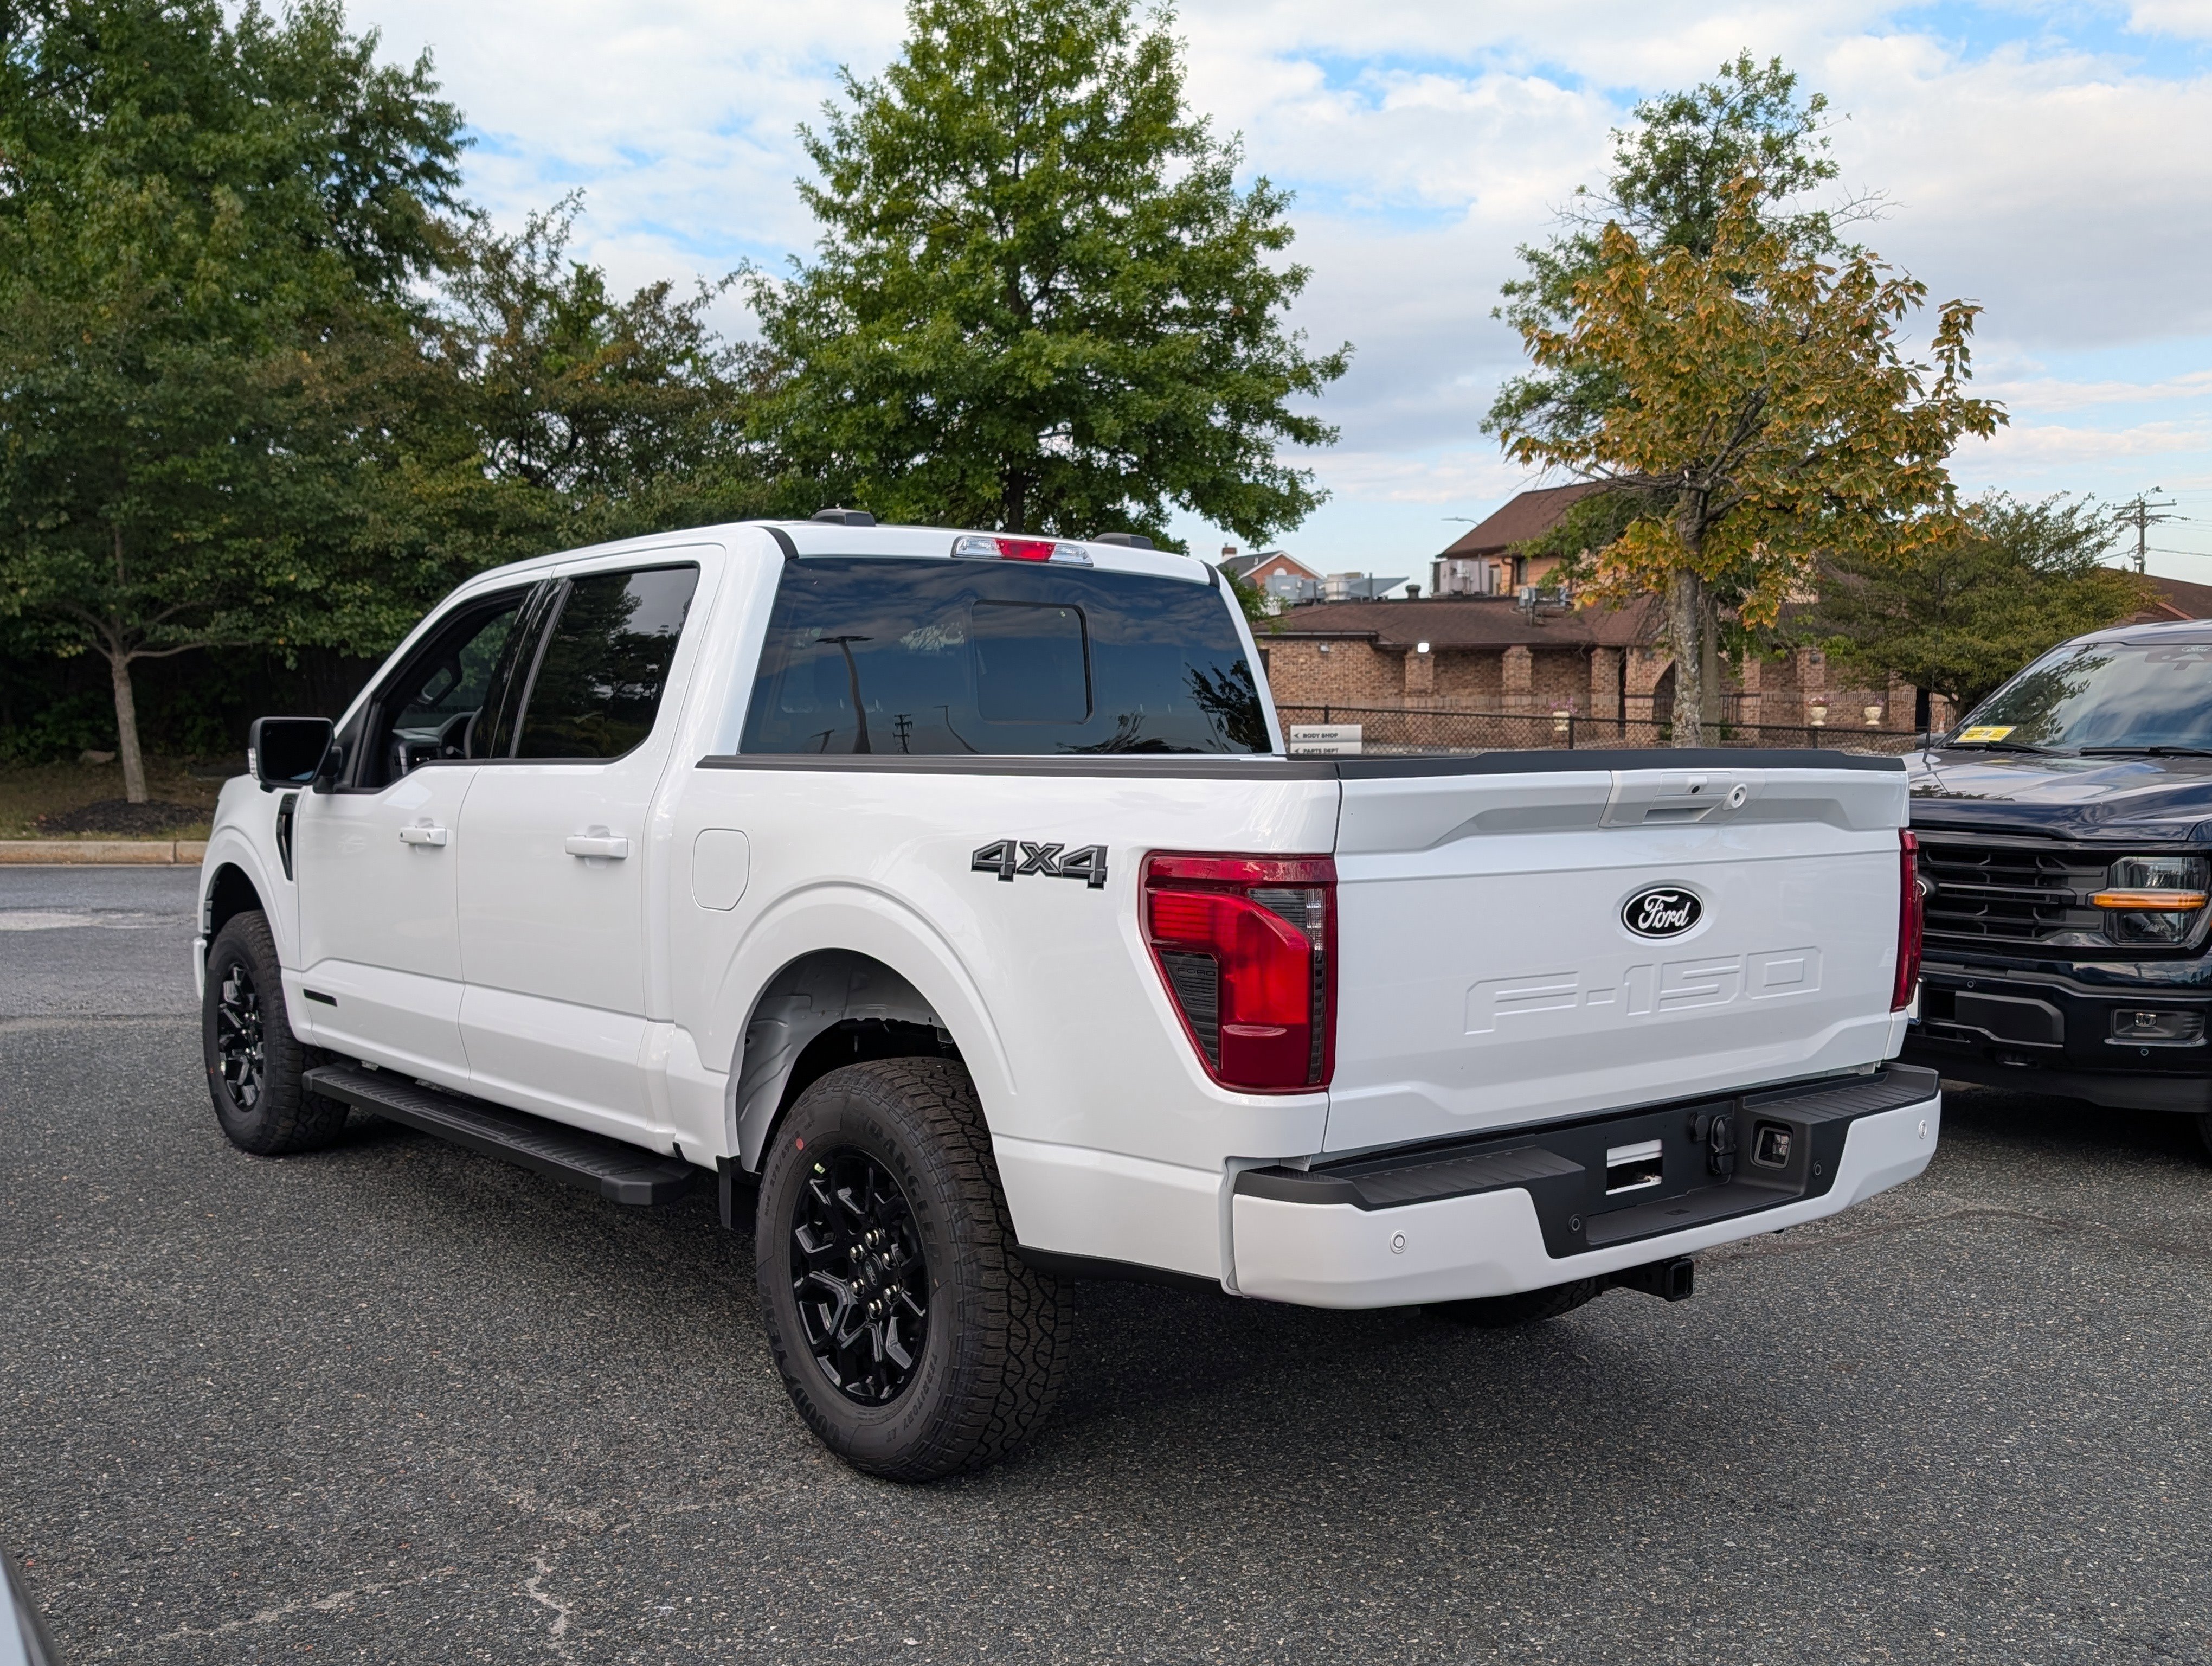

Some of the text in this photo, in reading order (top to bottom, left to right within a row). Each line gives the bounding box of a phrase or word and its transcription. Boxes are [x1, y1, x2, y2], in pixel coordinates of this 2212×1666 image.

[1638, 894, 1691, 930] Ford
[1177, 967, 1216, 976] FORD
[1464, 945, 1823, 1035] F-150
[903, 1352, 937, 1431] TERRITORY
